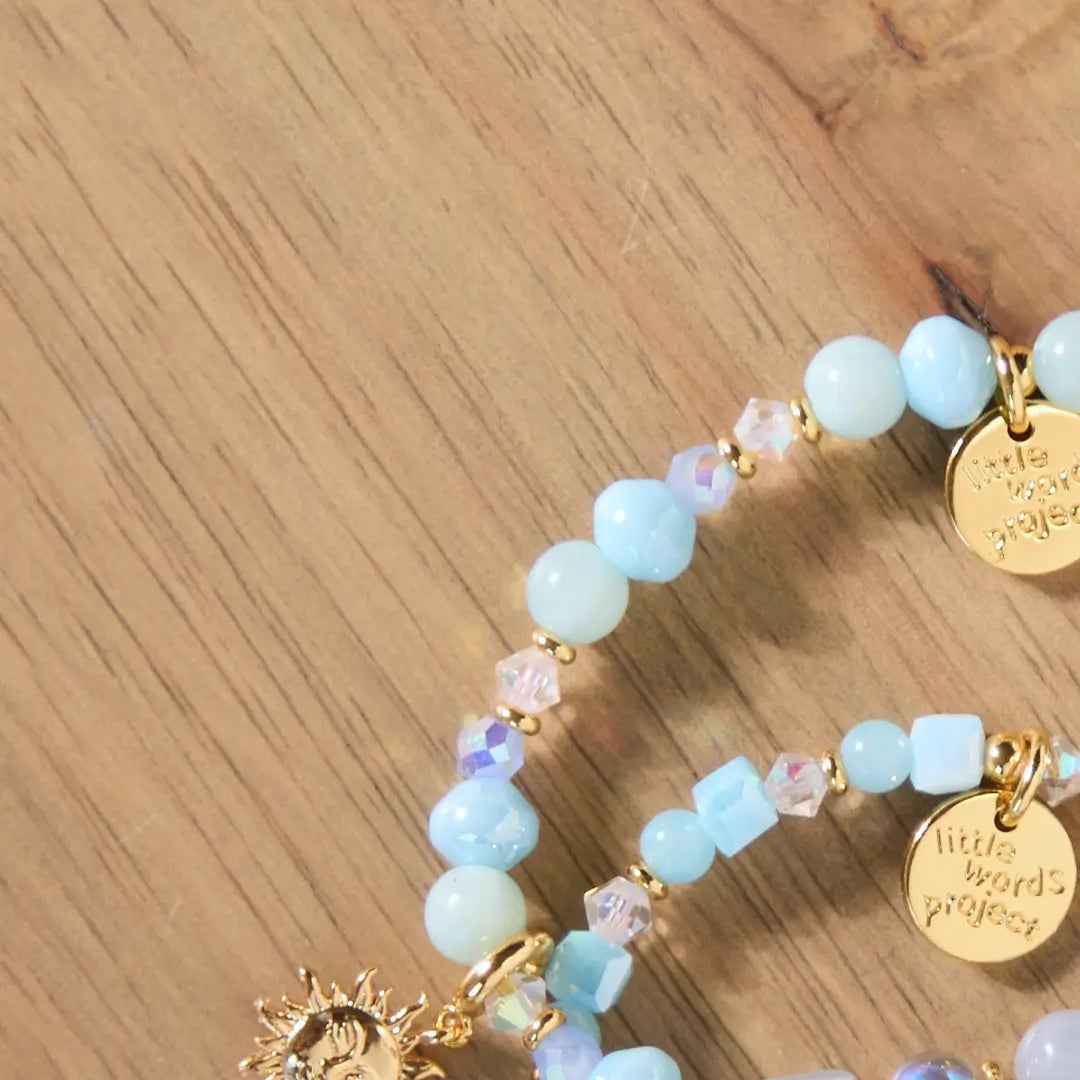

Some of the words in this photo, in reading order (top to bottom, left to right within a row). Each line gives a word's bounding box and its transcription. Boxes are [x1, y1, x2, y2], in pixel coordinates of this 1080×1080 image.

[963, 445, 1049, 491] little
[936, 827, 1016, 864] little
[964, 859, 1065, 898] words
[923, 890, 1040, 941] project
